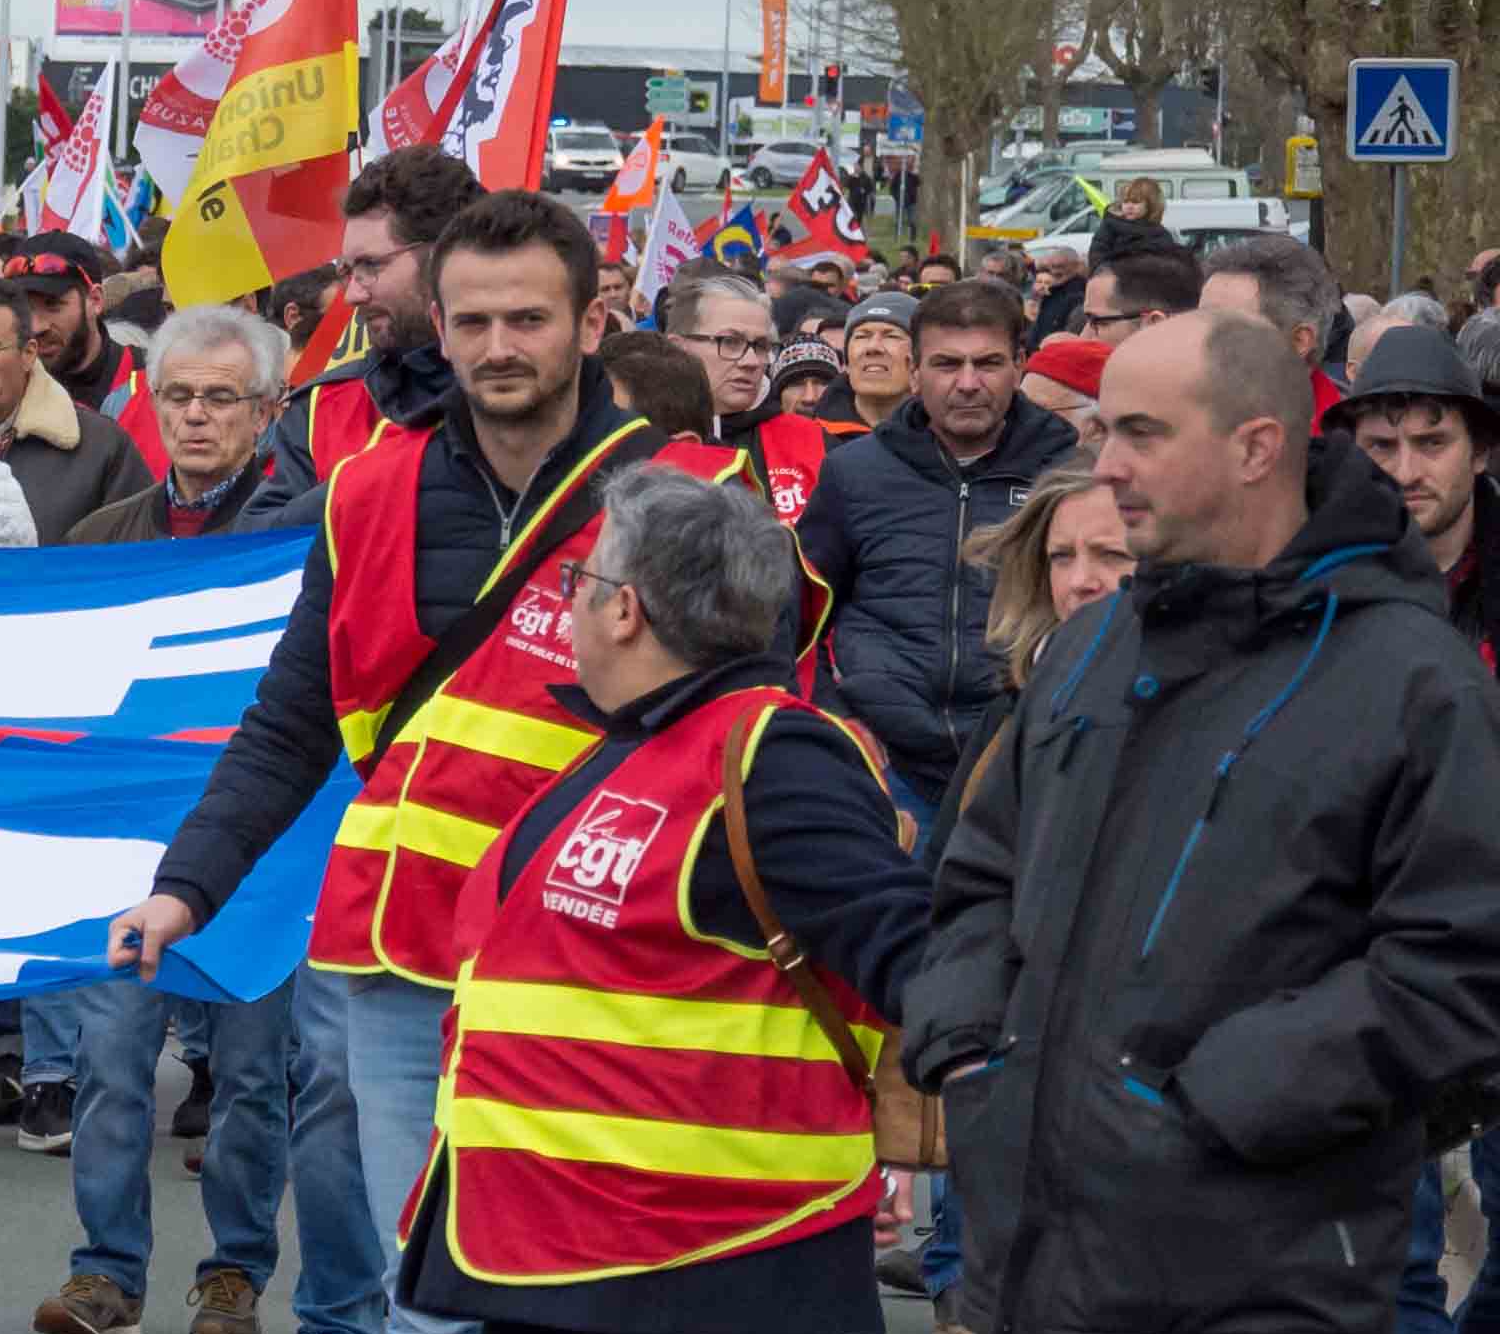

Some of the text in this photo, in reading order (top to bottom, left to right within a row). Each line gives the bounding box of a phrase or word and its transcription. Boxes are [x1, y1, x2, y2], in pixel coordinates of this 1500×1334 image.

[772, 483, 808, 513] gt
[511, 607, 554, 636] cgt
[556, 831, 646, 888] cgt
